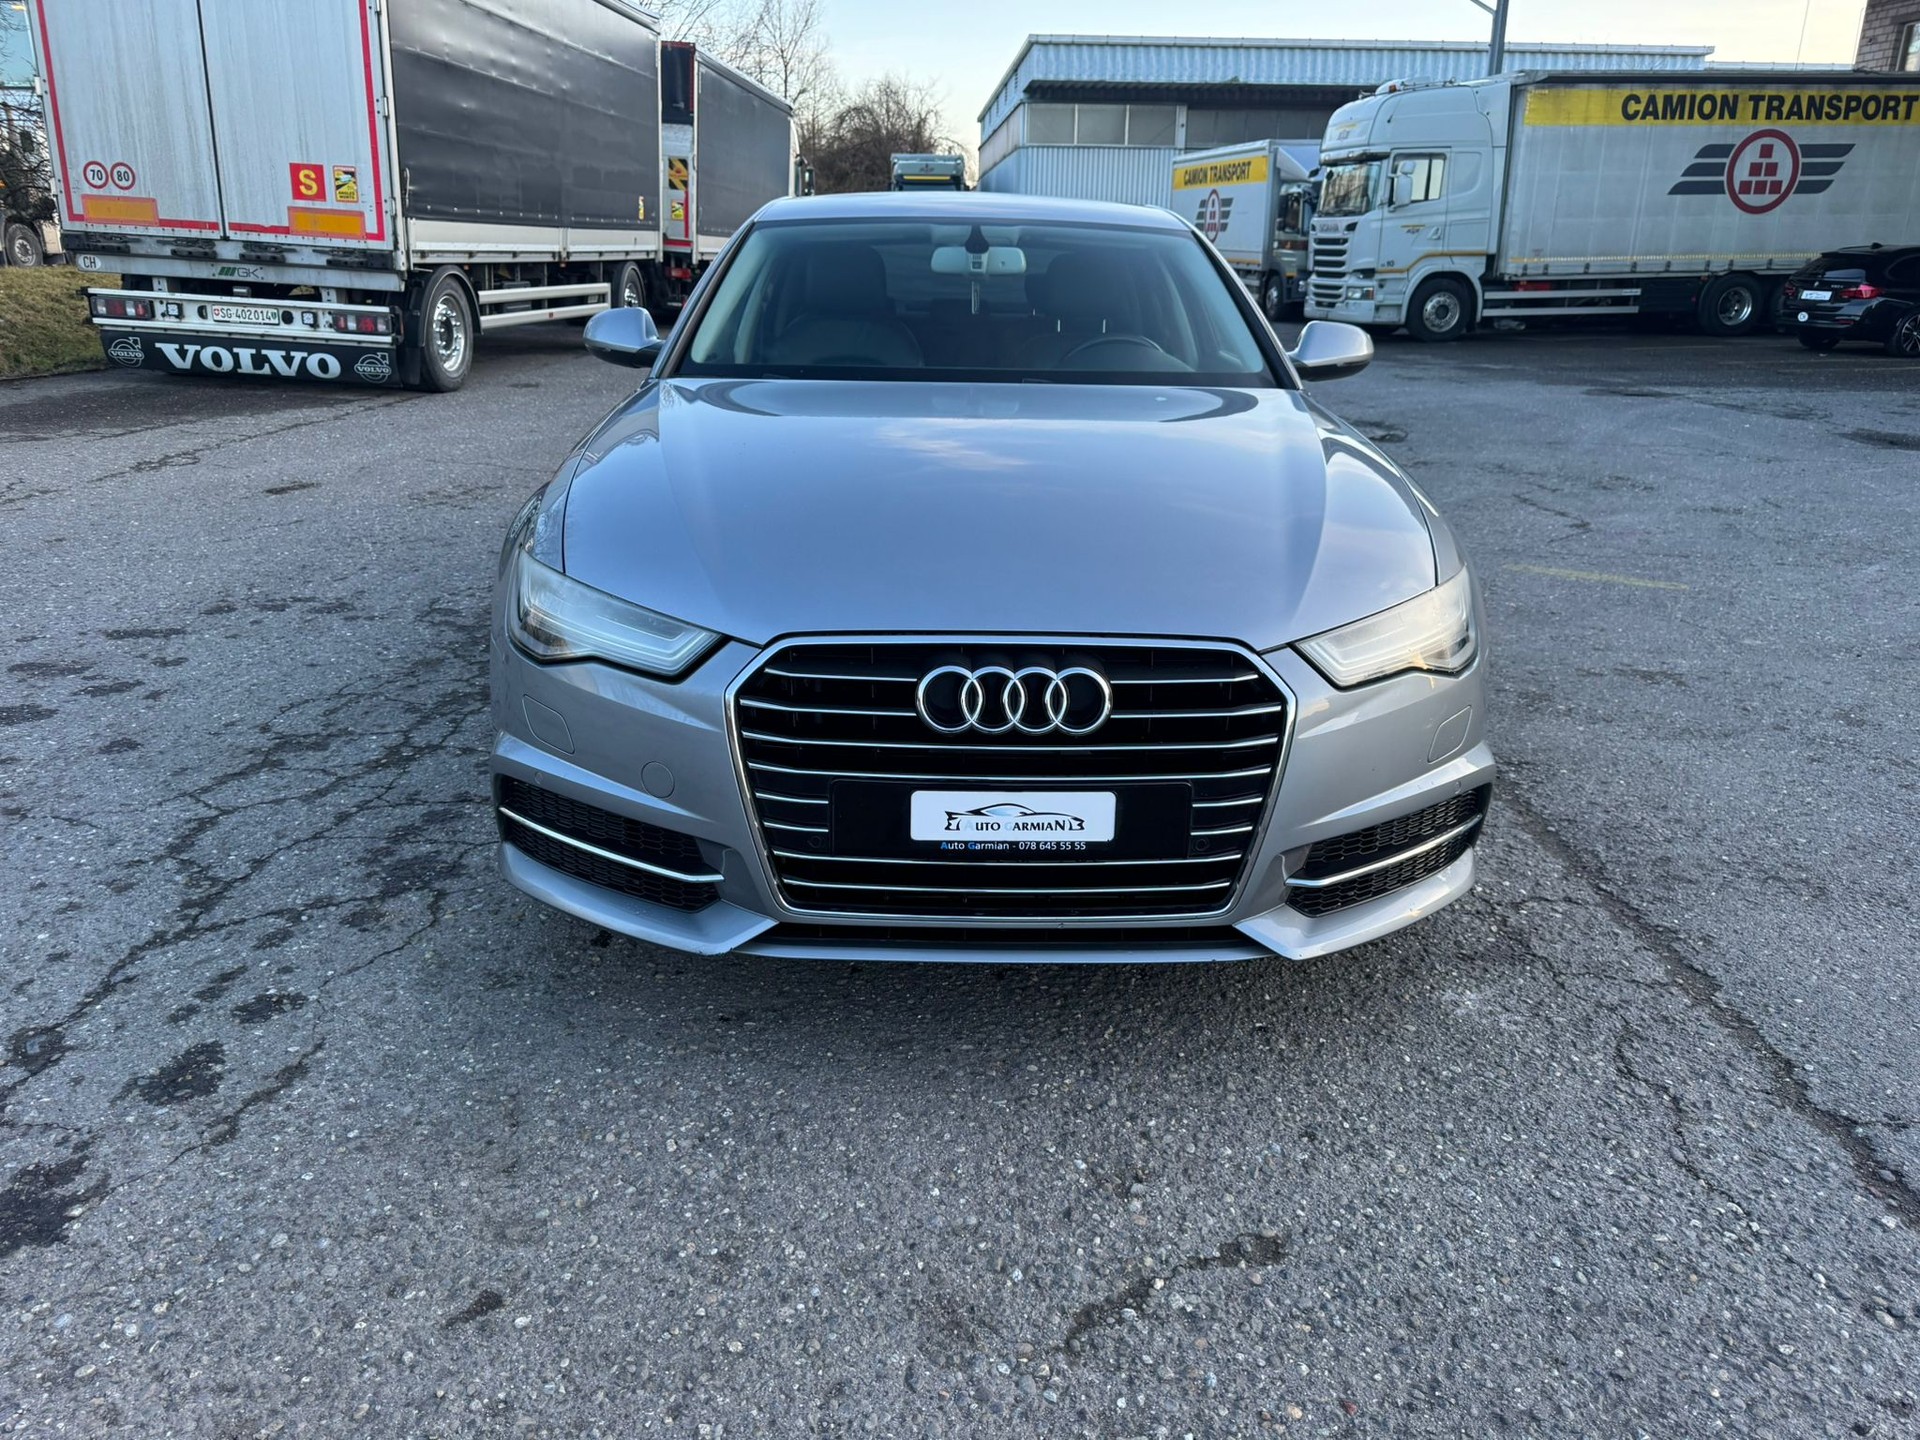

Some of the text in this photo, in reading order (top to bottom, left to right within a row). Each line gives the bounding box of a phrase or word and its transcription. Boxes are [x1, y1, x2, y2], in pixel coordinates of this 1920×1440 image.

[1621, 94, 1919, 120] CAMION TRANSPORT
[90, 169, 103, 181] 70
[116, 170, 130, 182] 80
[1183, 161, 1251, 186] CAMION TRANSPORT
[298, 169, 318, 196] S
[83, 256, 97, 268] CH
[110, 350, 142, 358] VOLVO
[155, 342, 341, 379] VOLVO
[941, 841, 965, 850] Auto
[967, 841, 1010, 850] Garmian
[1018, 841, 1037, 850] 078
[1039, 841, 1057, 850] 645
[1060, 841, 1072, 850] 55
[1074, 841, 1086, 850] 55
